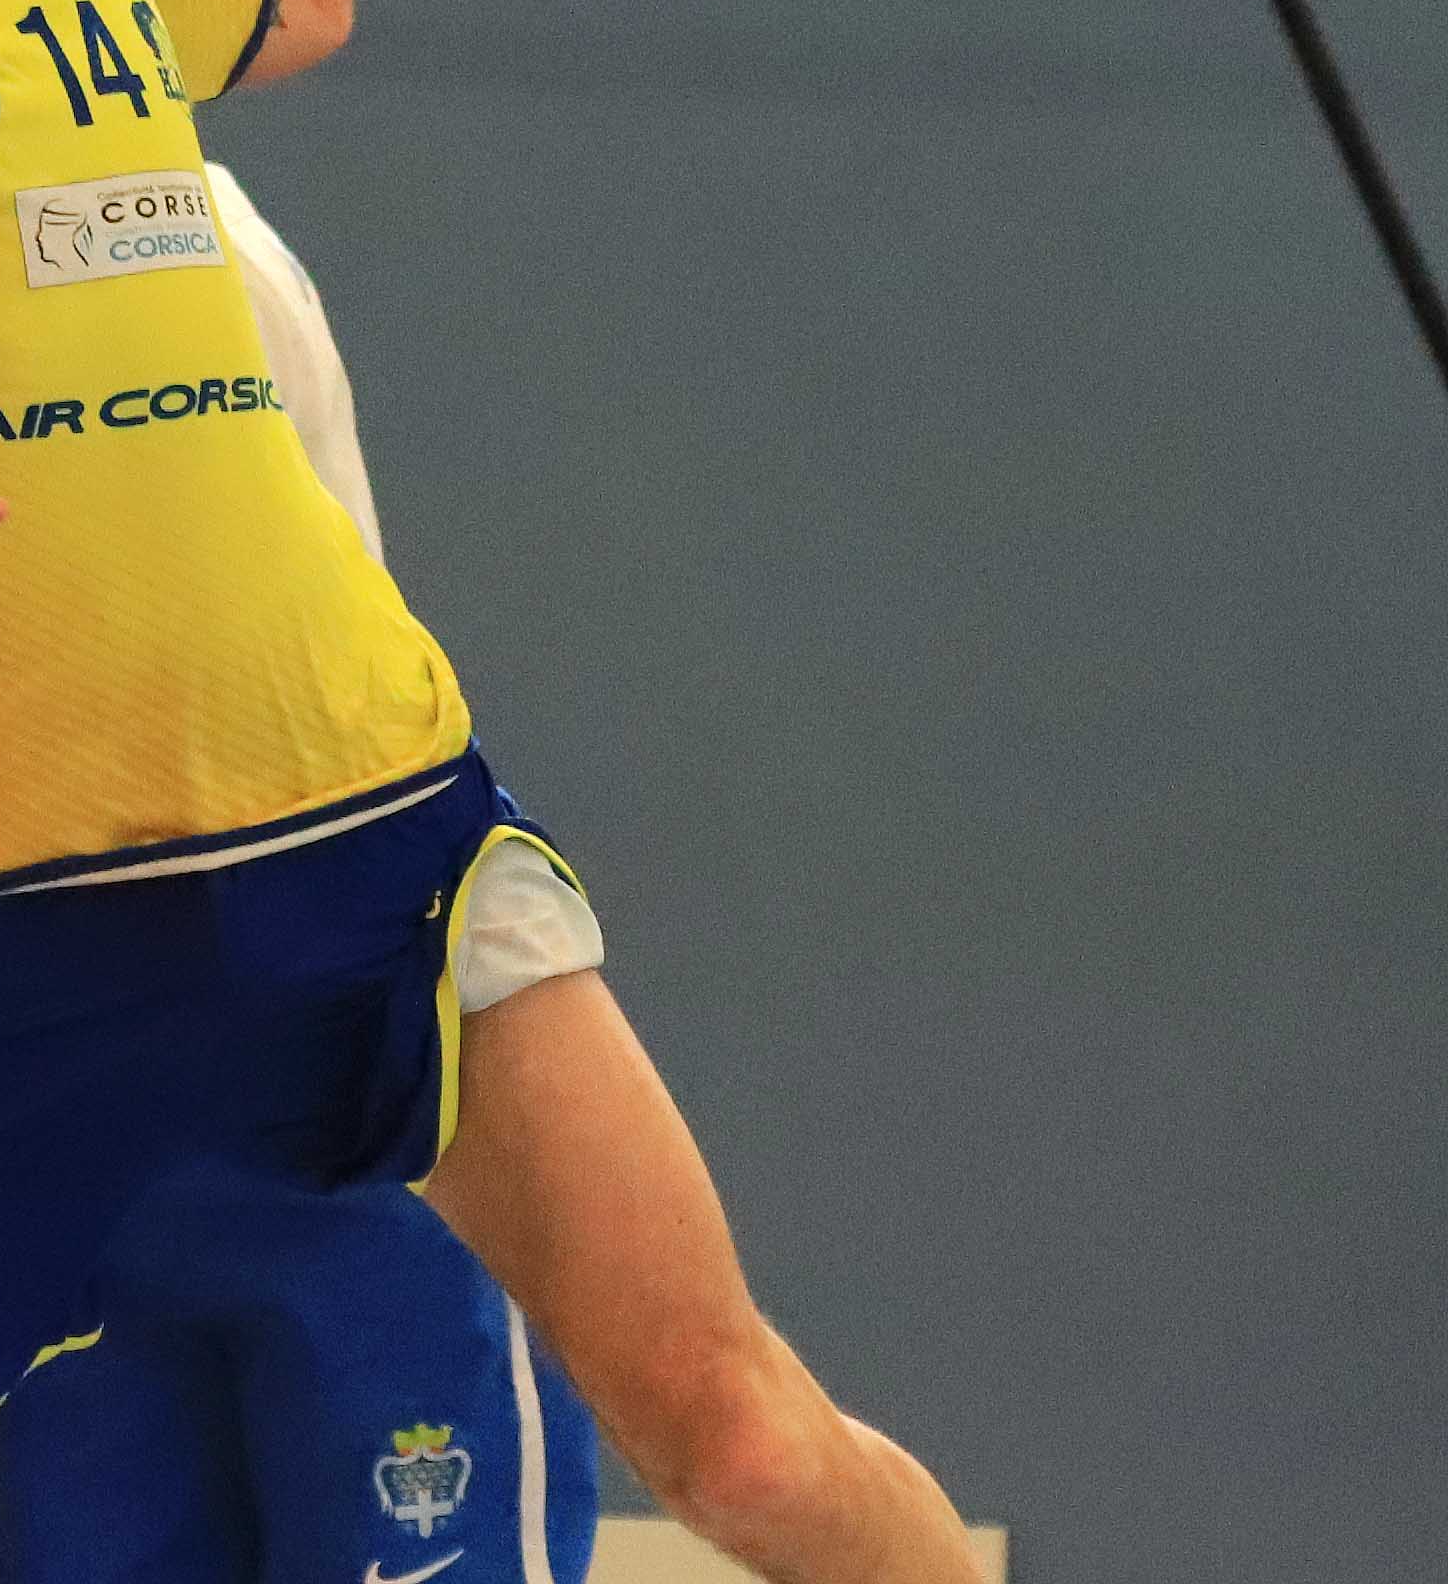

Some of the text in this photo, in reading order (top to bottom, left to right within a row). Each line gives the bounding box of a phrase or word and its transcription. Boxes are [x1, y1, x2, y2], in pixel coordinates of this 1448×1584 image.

[15, 0, 152, 128] 14
[101, 194, 209, 224] CORSE
[109, 231, 219, 262] CORSICA
